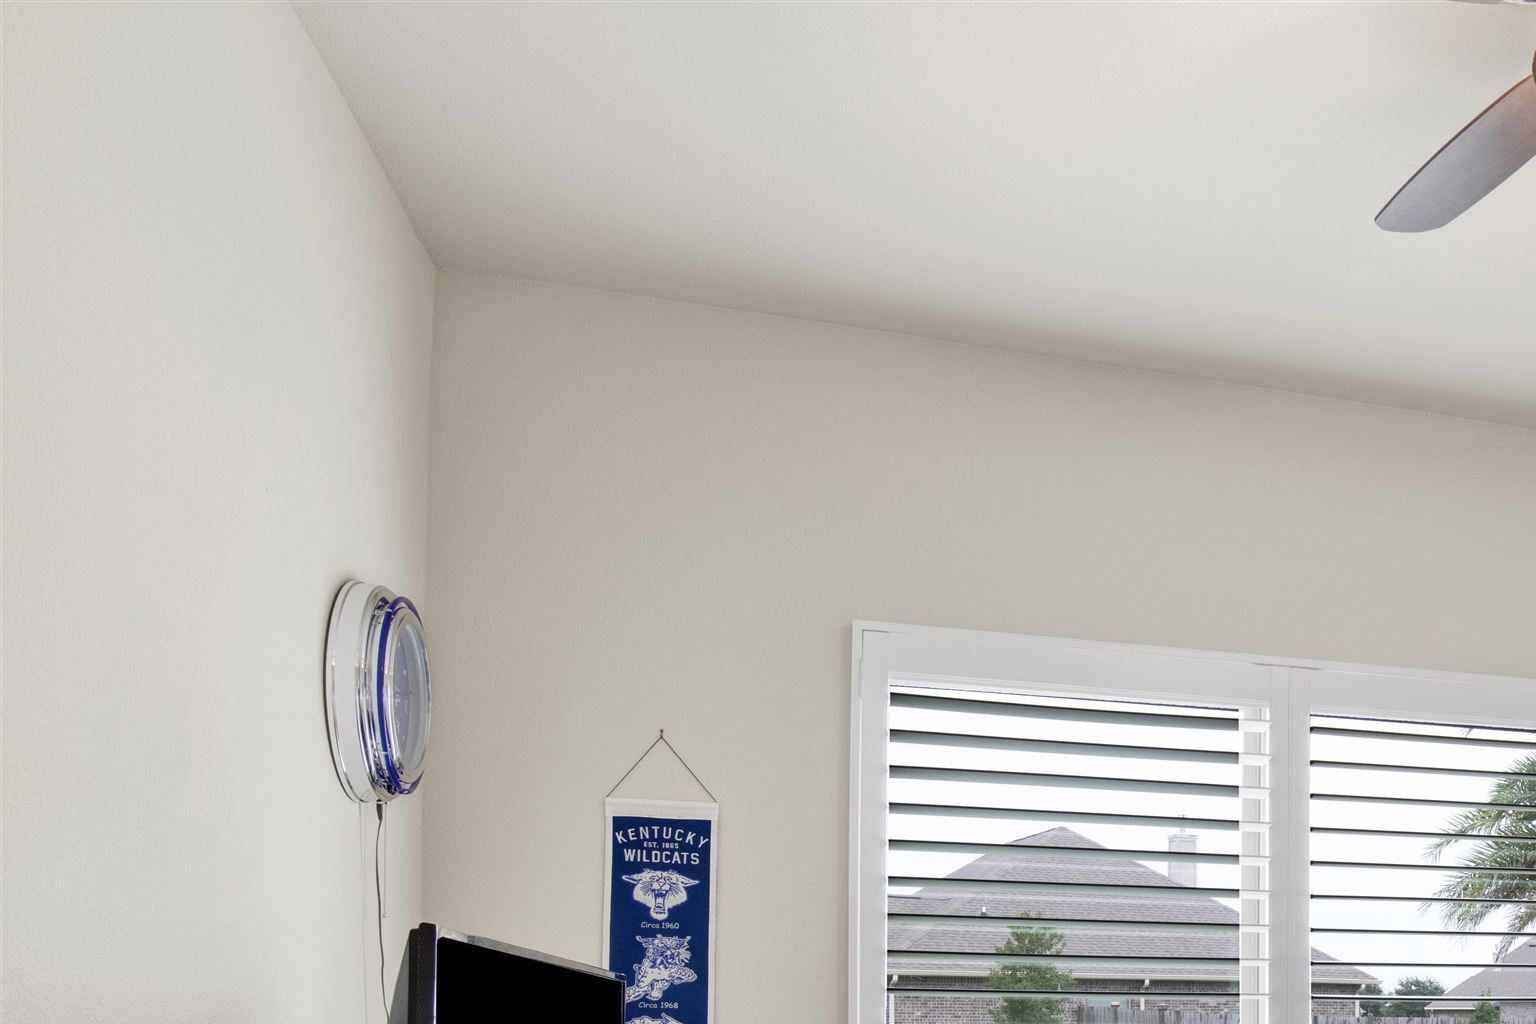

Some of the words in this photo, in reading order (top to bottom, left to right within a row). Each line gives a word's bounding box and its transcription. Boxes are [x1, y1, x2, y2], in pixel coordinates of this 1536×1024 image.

[615, 826, 709, 848] KENTUCKY
[624, 849, 700, 865] WILDCATS
[641, 921, 660, 929] Circa
[638, 1001, 658, 1009] Circa
[660, 1001, 679, 1009] 1968
